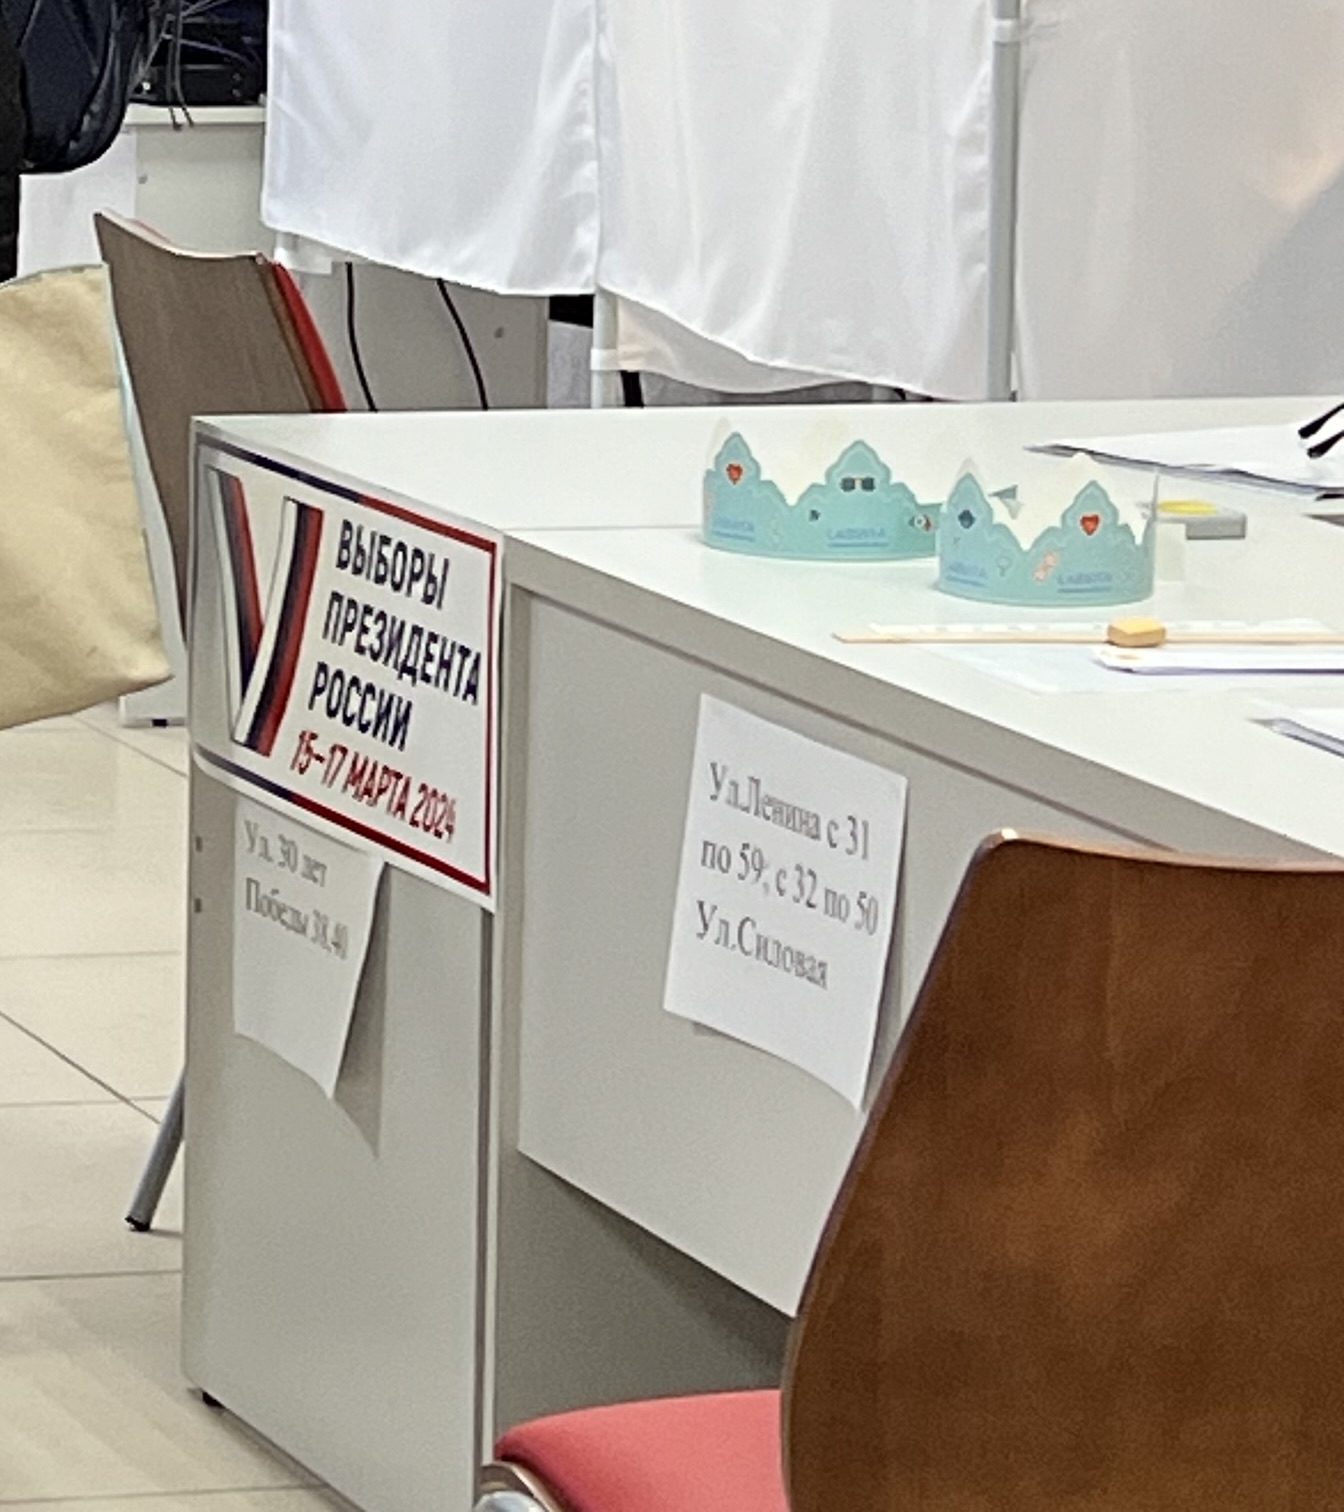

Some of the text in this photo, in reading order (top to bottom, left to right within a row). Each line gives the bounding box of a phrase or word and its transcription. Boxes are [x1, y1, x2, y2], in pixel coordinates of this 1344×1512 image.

[335, 518, 450, 610] ВЫБОРЫ
[322, 589, 482, 706] ПРЕЗИДЕНТА
[308, 660, 413, 752] РОССИИ
[341, 751, 412, 823] МАРТА
[408, 782, 457, 844] 2024
[826, 818, 840, 849] с
[845, 814, 870, 861] 31
[700, 839, 733, 874] по
[775, 867, 788, 898] с
[792, 862, 819, 909] 32
[823, 886, 852, 924] по
[853, 890, 880, 937] 50
